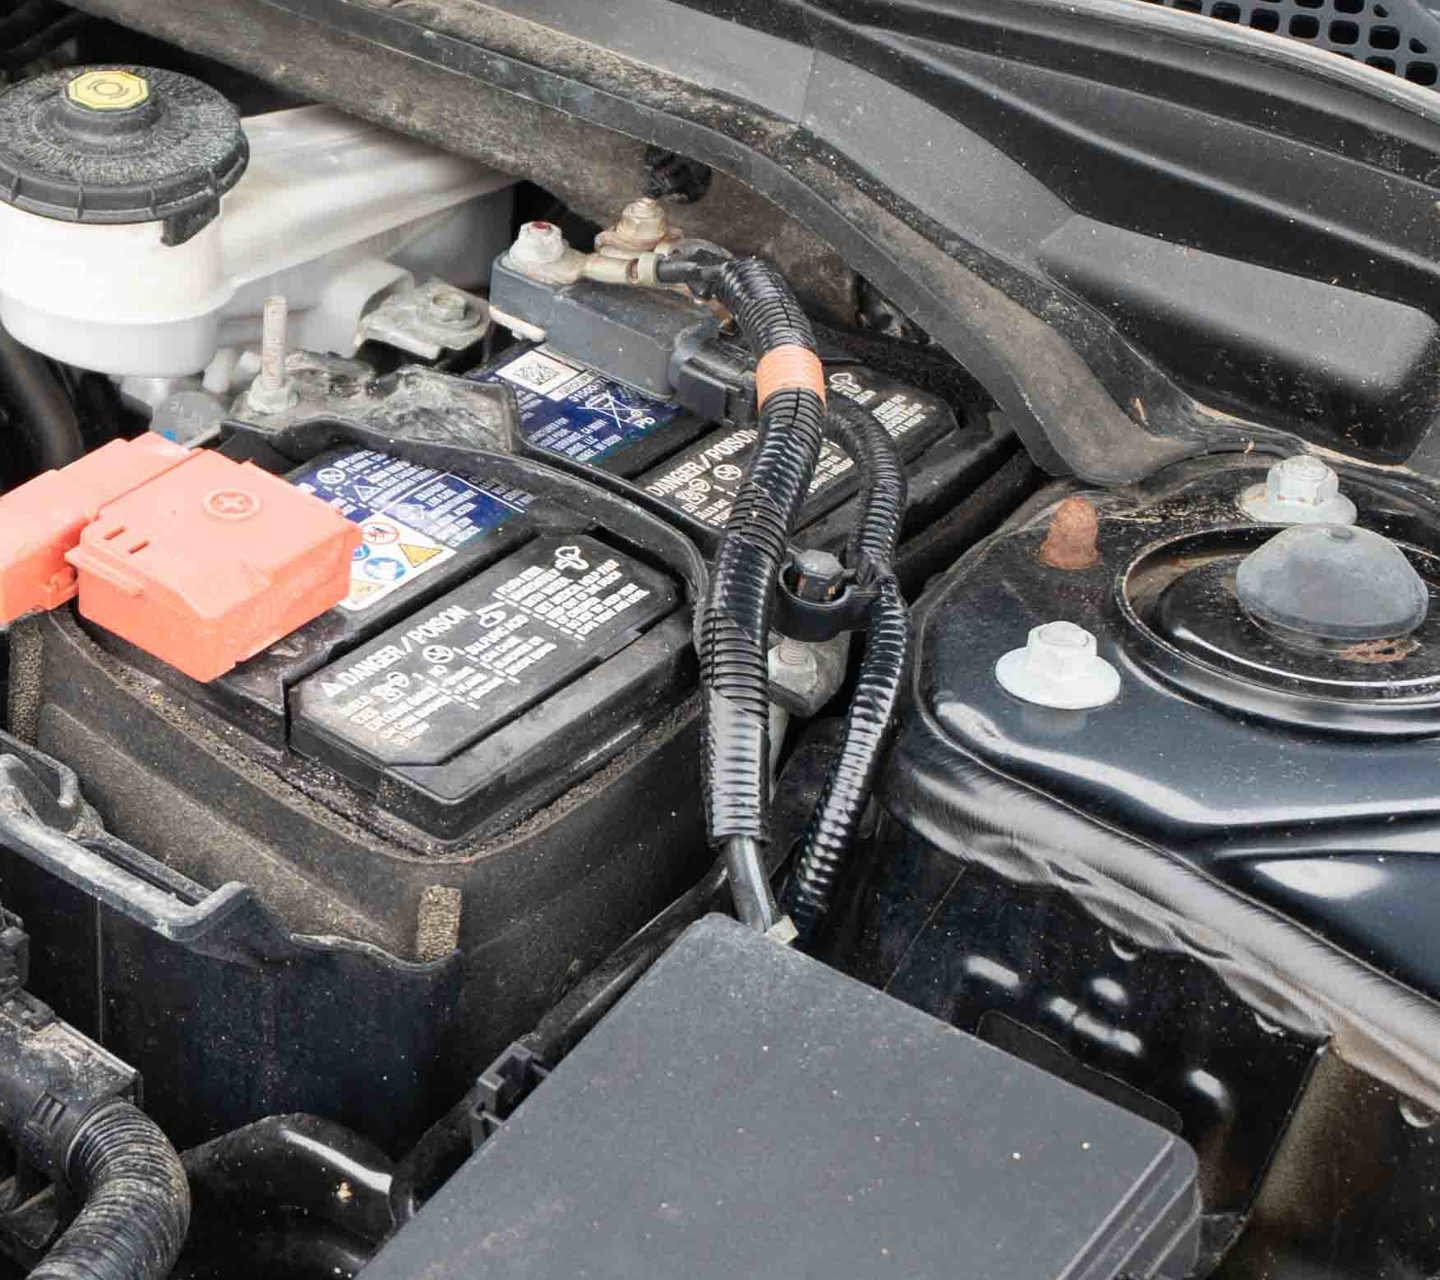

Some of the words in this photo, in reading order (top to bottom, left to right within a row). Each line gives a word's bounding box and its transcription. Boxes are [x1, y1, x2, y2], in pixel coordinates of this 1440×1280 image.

[645, 461, 707, 498] DANGER
[336, 644, 407, 687] DANGER
[406, 604, 472, 645] POISON
